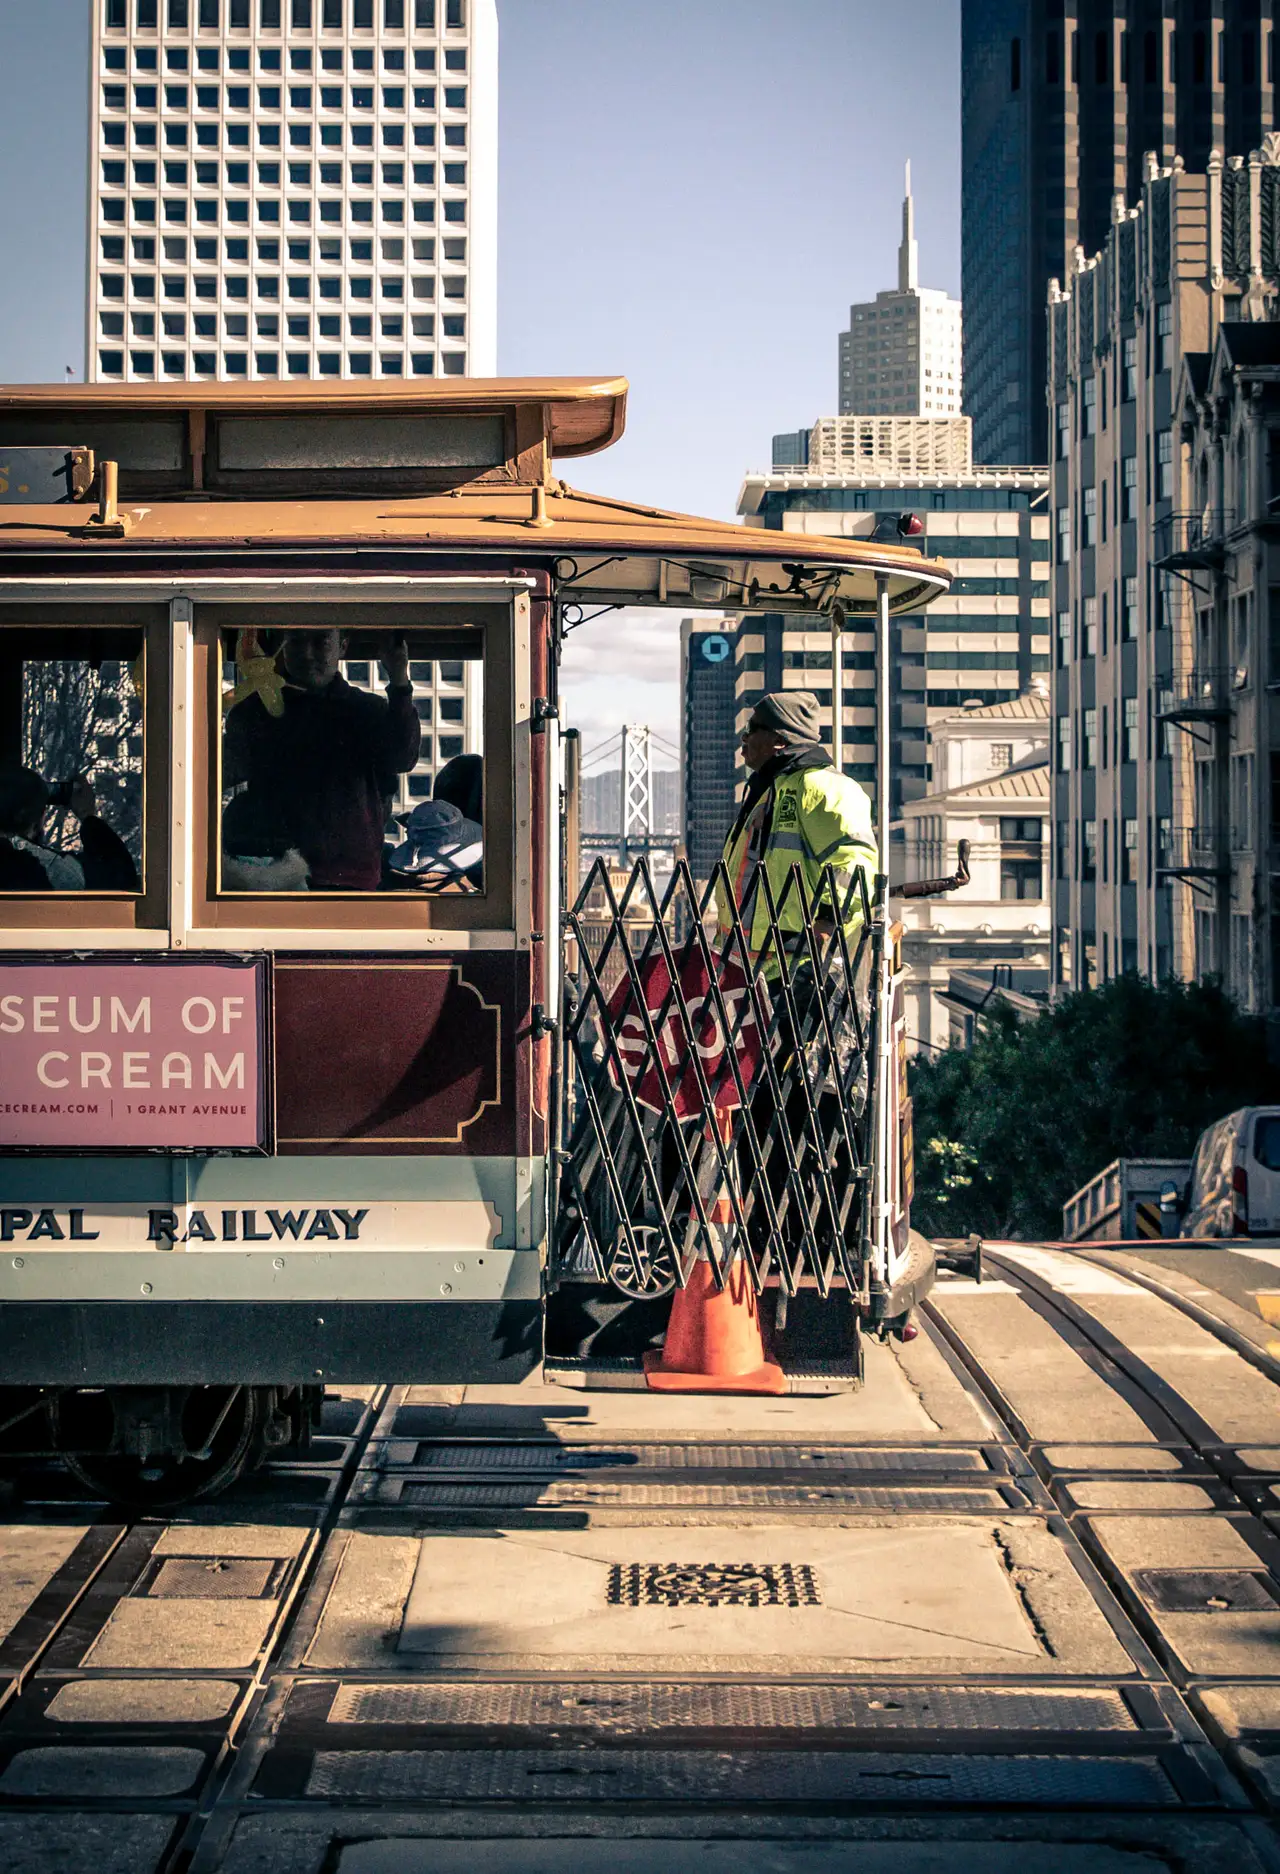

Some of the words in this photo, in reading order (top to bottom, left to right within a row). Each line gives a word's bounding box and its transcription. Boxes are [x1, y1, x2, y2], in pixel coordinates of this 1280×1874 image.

[0, 996, 150, 1034] SEUM
[181, 996, 245, 1034] OF
[617, 987, 757, 1077] STOP
[37, 1051, 245, 1090] CREAM
[126, 1105, 131, 1114] 1
[138, 1105, 186, 1115] GRANT
[192, 1105, 247, 1115] AVENUE
[0, 1208, 100, 1241] PAL
[146, 1208, 371, 1242] RAILWAY
